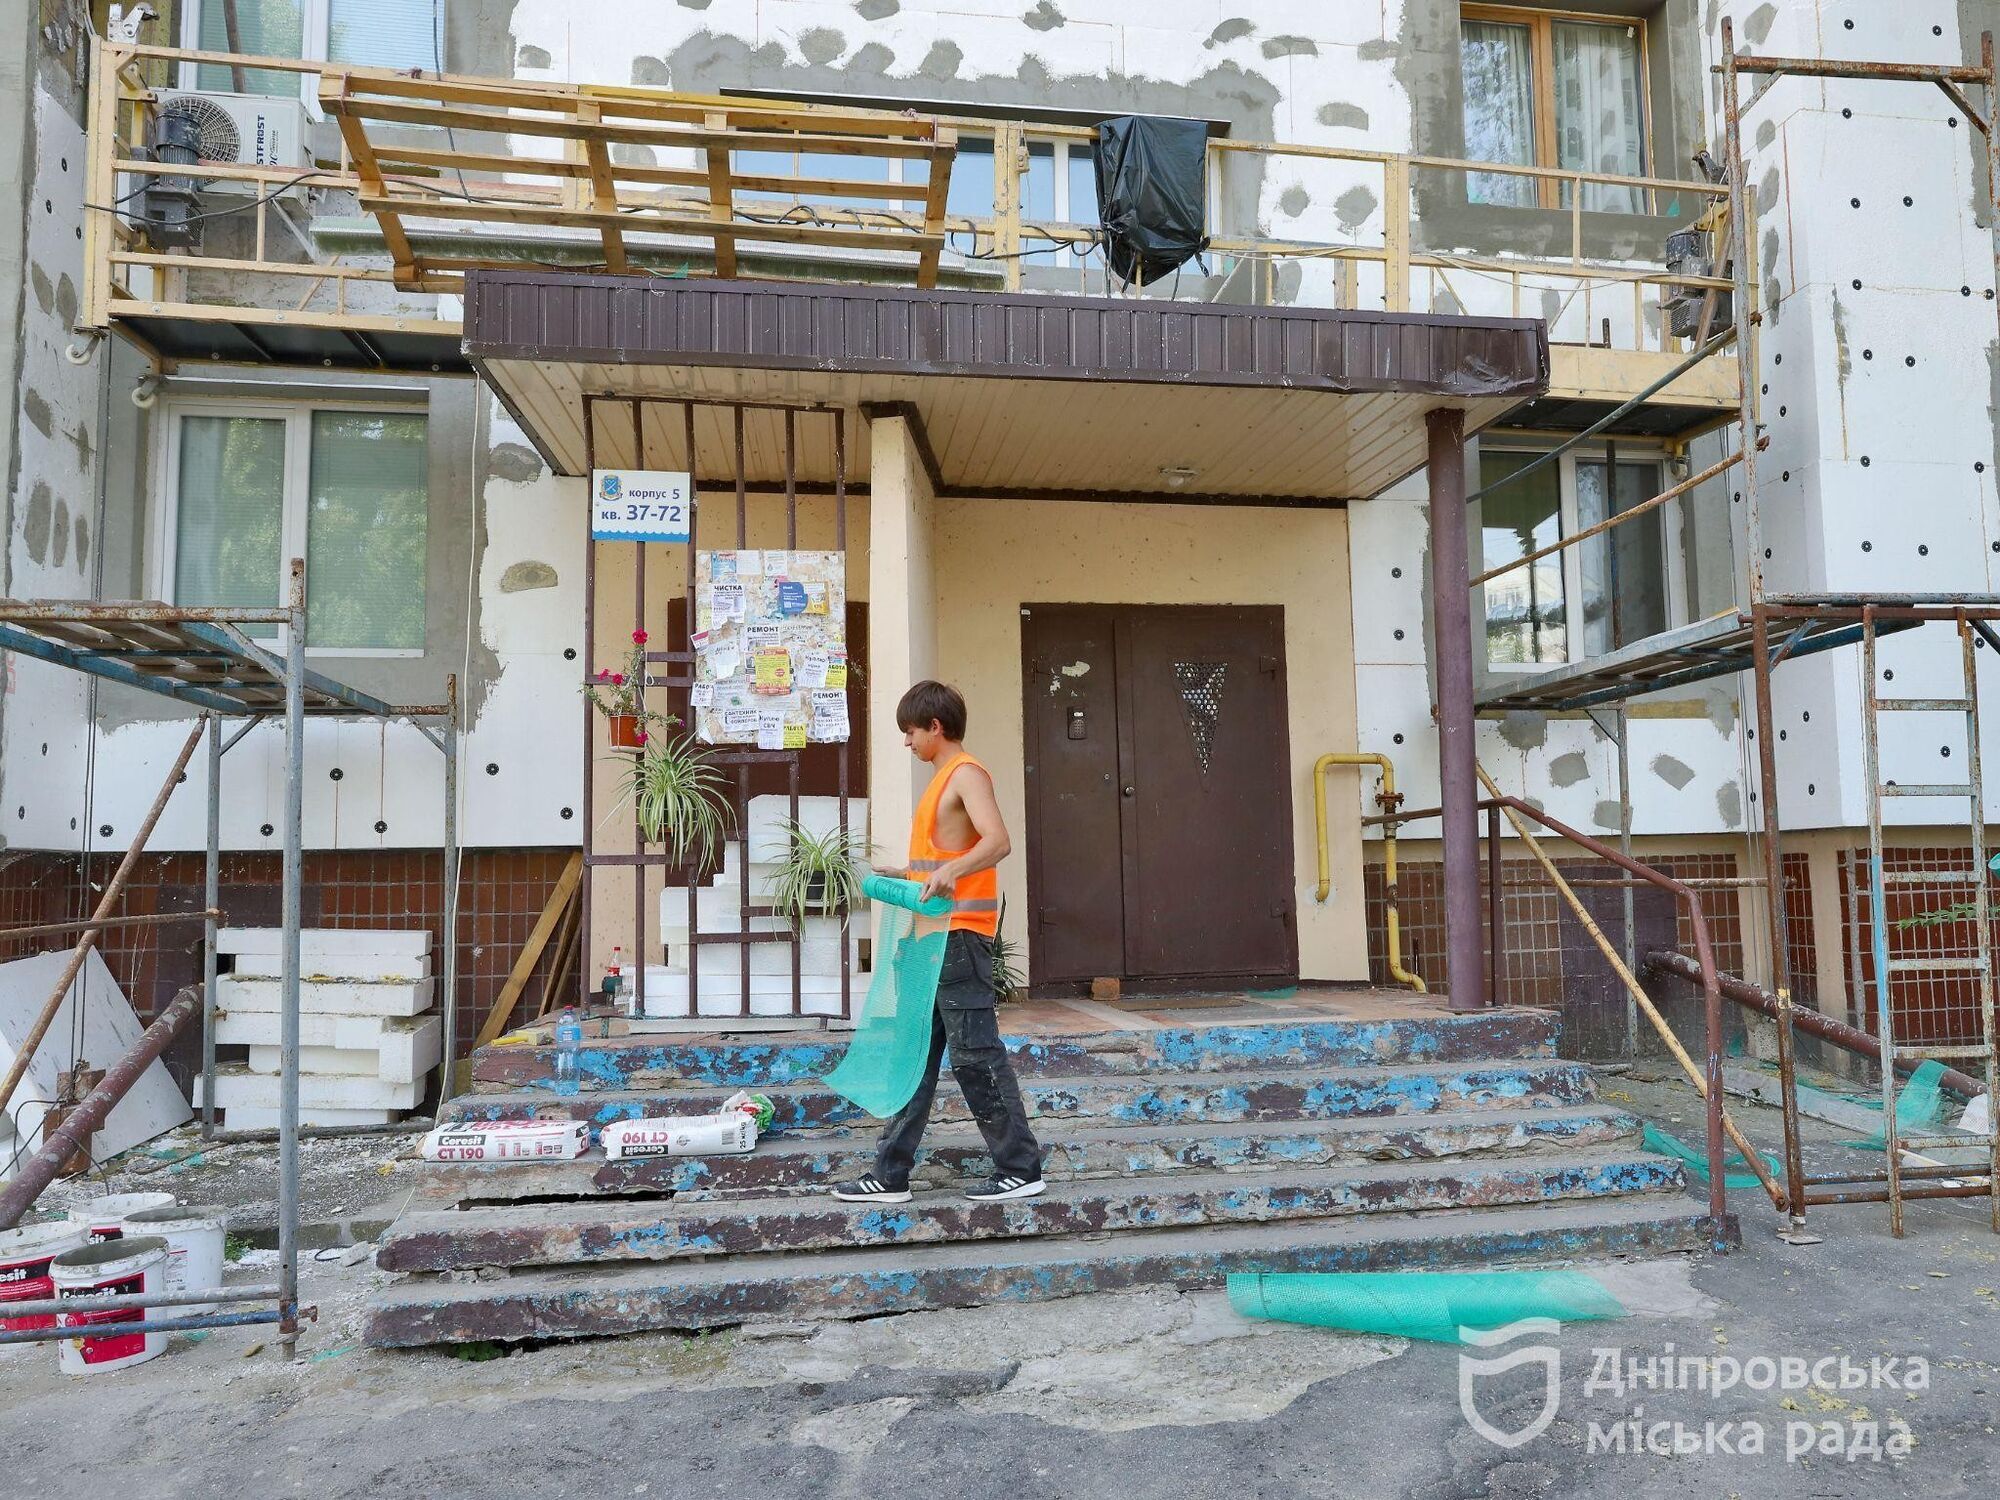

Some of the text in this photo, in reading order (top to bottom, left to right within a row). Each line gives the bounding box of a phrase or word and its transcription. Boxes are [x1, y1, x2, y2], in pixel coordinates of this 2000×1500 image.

[256, 115, 265, 165] STFROST
[629, 488, 680, 500] корпус 5
[601, 504, 681, 522] кв. 37-72
[442, 1135, 483, 1146] Ceresit
[622, 1132, 647, 1144] 190
[459, 1147, 485, 1159] 190
[624, 1146, 666, 1155] Ceresit
[87, 1233, 106, 1245] sit
[0, 1268, 27, 1282] esit
